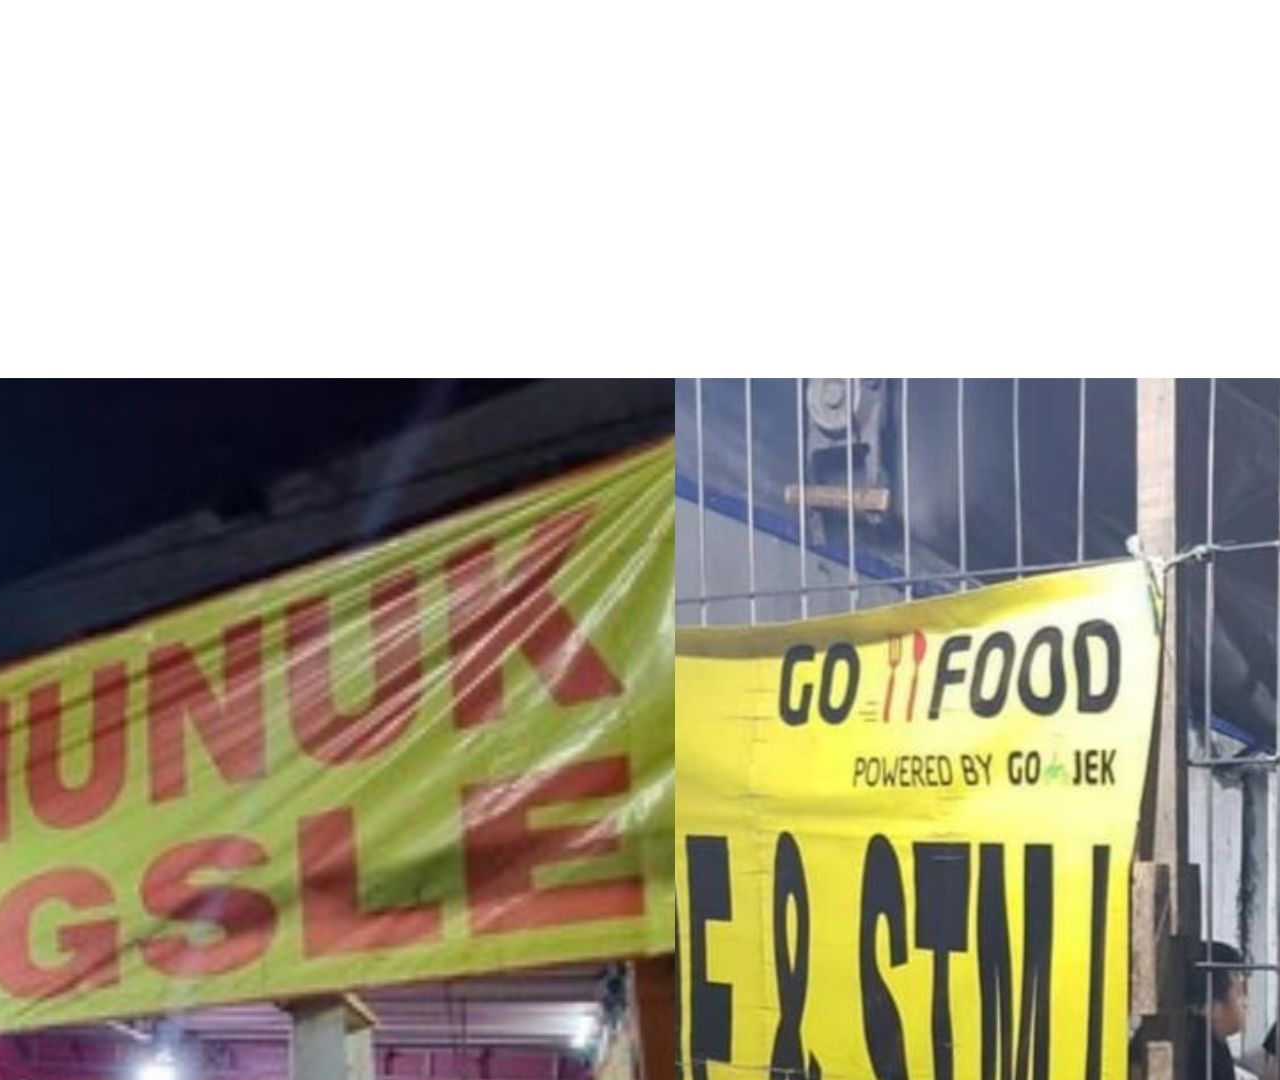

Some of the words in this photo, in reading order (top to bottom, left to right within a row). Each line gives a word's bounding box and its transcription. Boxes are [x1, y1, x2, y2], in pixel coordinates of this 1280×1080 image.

[778, 641, 861, 727] GO
[928, 619, 1121, 721] FOOD
[853, 754, 953, 788] POWERED
[961, 753, 993, 788] BY
[1007, 749, 1041, 785] GO
[1072, 748, 1118, 786] JEK
